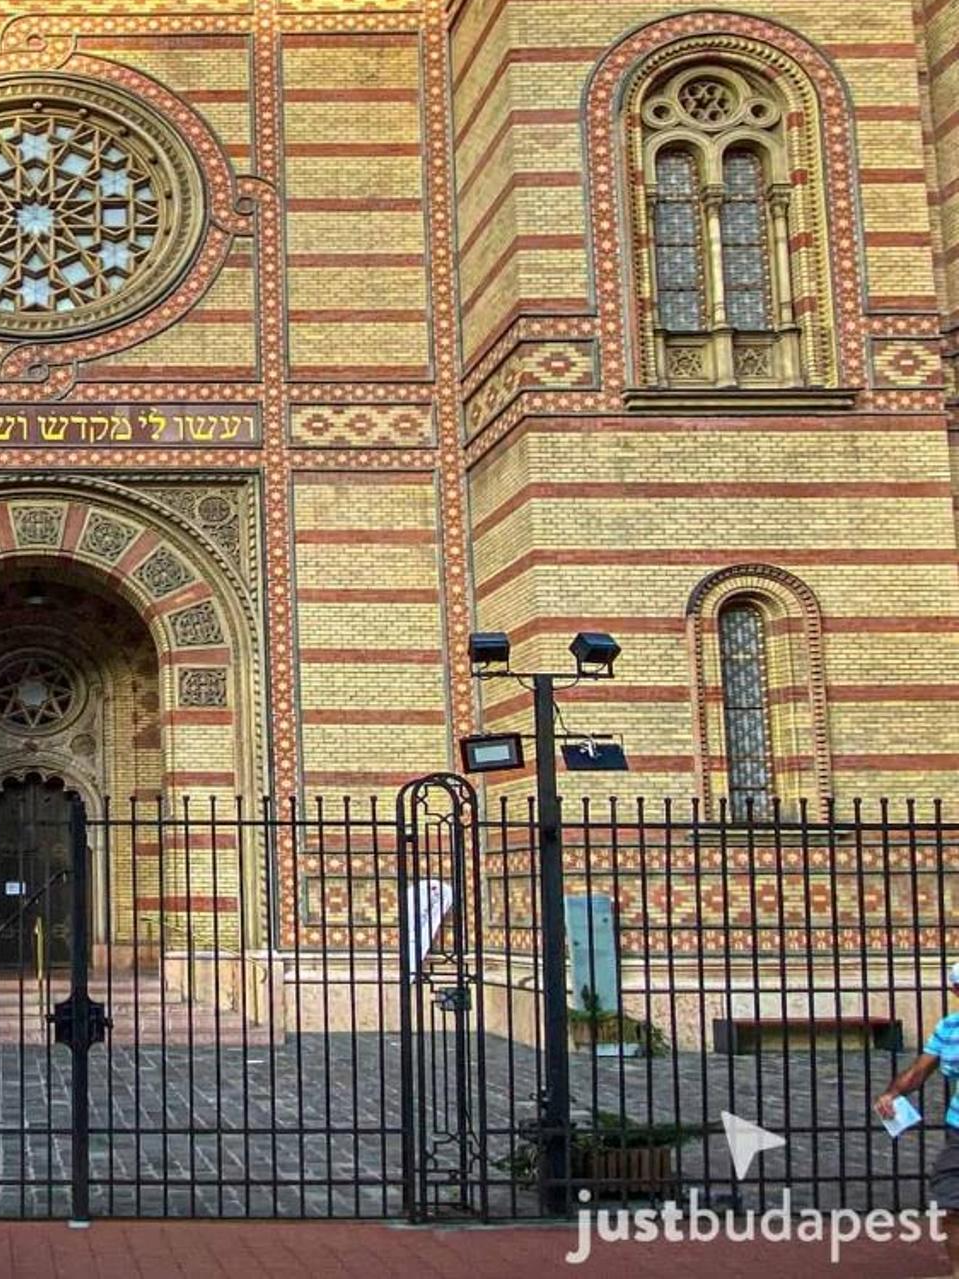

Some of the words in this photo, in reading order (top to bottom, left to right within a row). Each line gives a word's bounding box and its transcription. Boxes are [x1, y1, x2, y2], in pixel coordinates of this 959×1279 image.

[37, 415, 133, 444] מקדש
[138, 407, 167, 441] לי
[172, 415, 255, 441] ועשו
